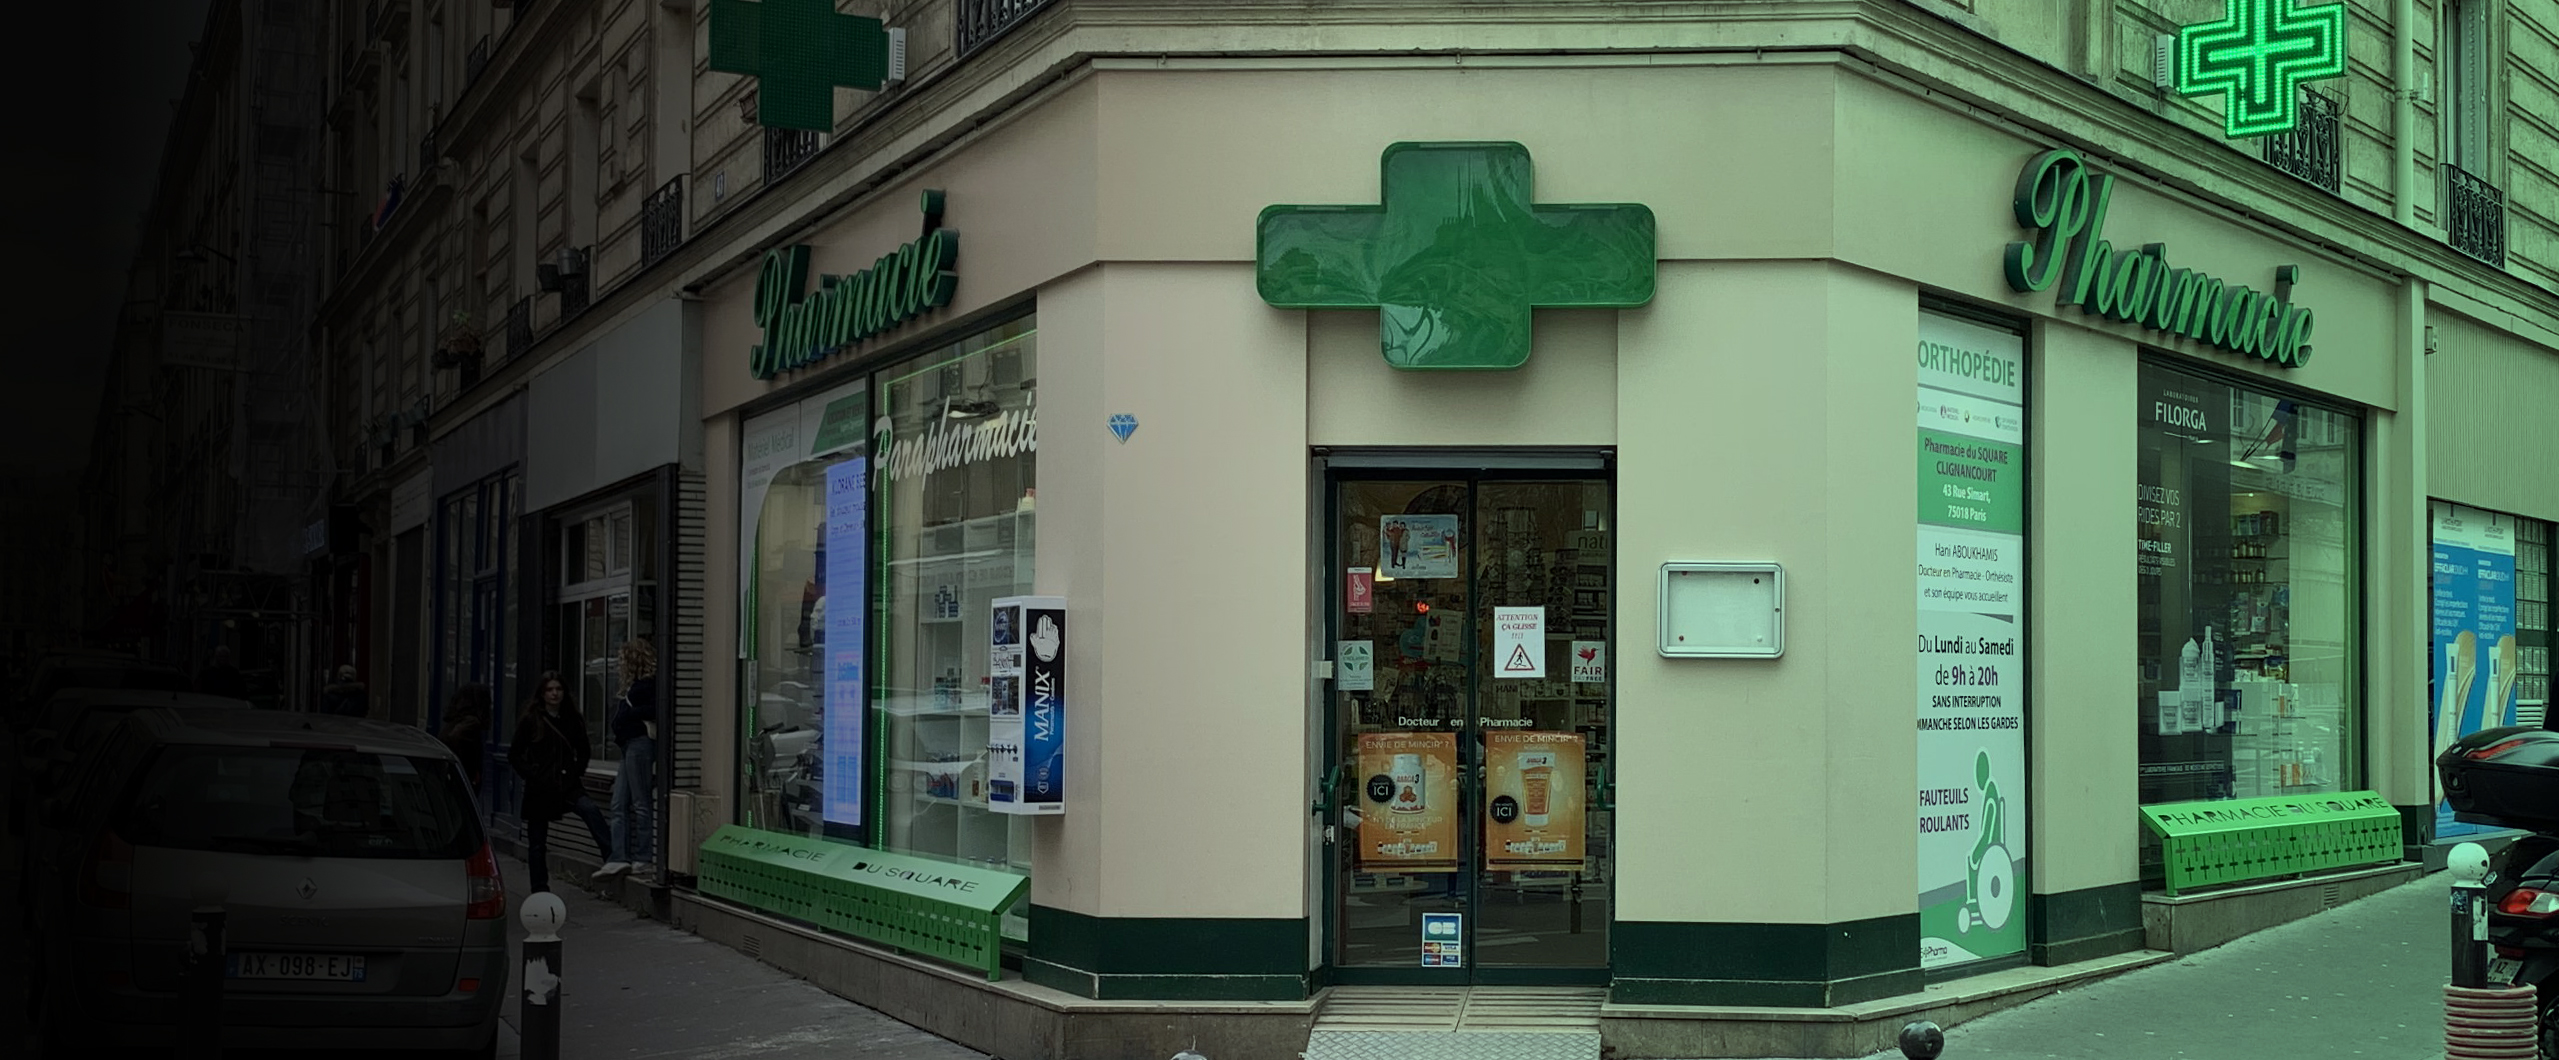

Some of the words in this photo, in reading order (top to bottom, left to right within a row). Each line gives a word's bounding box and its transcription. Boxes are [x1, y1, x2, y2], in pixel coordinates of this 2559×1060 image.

[2005, 149, 2313, 368] Pharmacie
[751, 189, 959, 380] Pharmacie
[168, 318, 244, 333] FONSECA
[1917, 340, 2015, 388] ORTHOPÉDIE
[2155, 401, 2207, 431] FILORGA
[873, 392, 1037, 491] Parapharmacie
[1924, 437, 1966, 457] Pharmacie
[1966, 445, 1977, 459] du
[1977, 447, 2008, 465] SQUARE
[1936, 461, 1997, 482] CLIGNANCOURT
[1943, 484, 1952, 497] 43
[1952, 485, 1966, 499] Rue
[1948, 505, 1969, 520] 75018
[1970, 506, 1987, 521] Paris
[2176, 512, 2181, 528] 2
[1918, 564, 1942, 577] Docteur
[1943, 570, 1951, 578] en
[1952, 567, 1981, 581] Pharmacie
[1924, 588, 1931, 598] et
[1931, 589, 1942, 598] son
[1943, 588, 1964, 601] équipe
[1964, 591, 1978, 601] vous
[1501, 623, 1511, 631] ÇA
[1918, 634, 1933, 653] Du
[1934, 635, 1963, 654] Lundi
[1965, 640, 1977, 654] au
[1978, 637, 2014, 656] Samedi
[1574, 666, 1602, 675] FAIR
[1935, 664, 1949, 685] de
[1952, 664, 1966, 685] 9h
[1968, 665, 1975, 685] à
[1977, 665, 1998, 686] 20h
[1034, 668, 1051, 742] MANIX
[1932, 695, 1951, 708] SANS
[1952, 695, 2001, 708] INTERRUPTION
[1399, 716, 1440, 727] Docteur
[1451, 718, 1464, 727] en
[1480, 716, 1533, 727] Pharmacie
[1953, 717, 1976, 730] SELON
[1977, 717, 1990, 730] LES
[1991, 716, 2019, 730] GARDES
[1365, 741, 1392, 749] ENVIE
[1494, 735, 1521, 743] ENVIE
[1523, 735, 1536, 743] DE
[1373, 786, 1388, 796] ICI
[1919, 788, 1969, 806] FAUTEUILS
[1497, 807, 1512, 816] ICI
[2157, 804, 2284, 827] PHARMACIE
[2285, 802, 2315, 816] DU
[2314, 797, 2388, 814] SQUARE
[1919, 814, 1969, 833] ROULANTS
[719, 834, 826, 862] PHARMACIE
[852, 862, 883, 873] DU
[885, 867, 980, 893] SQUARE
[242, 954, 352, 979] AX-098-EJ
[353, 968, 364, 980] 75
